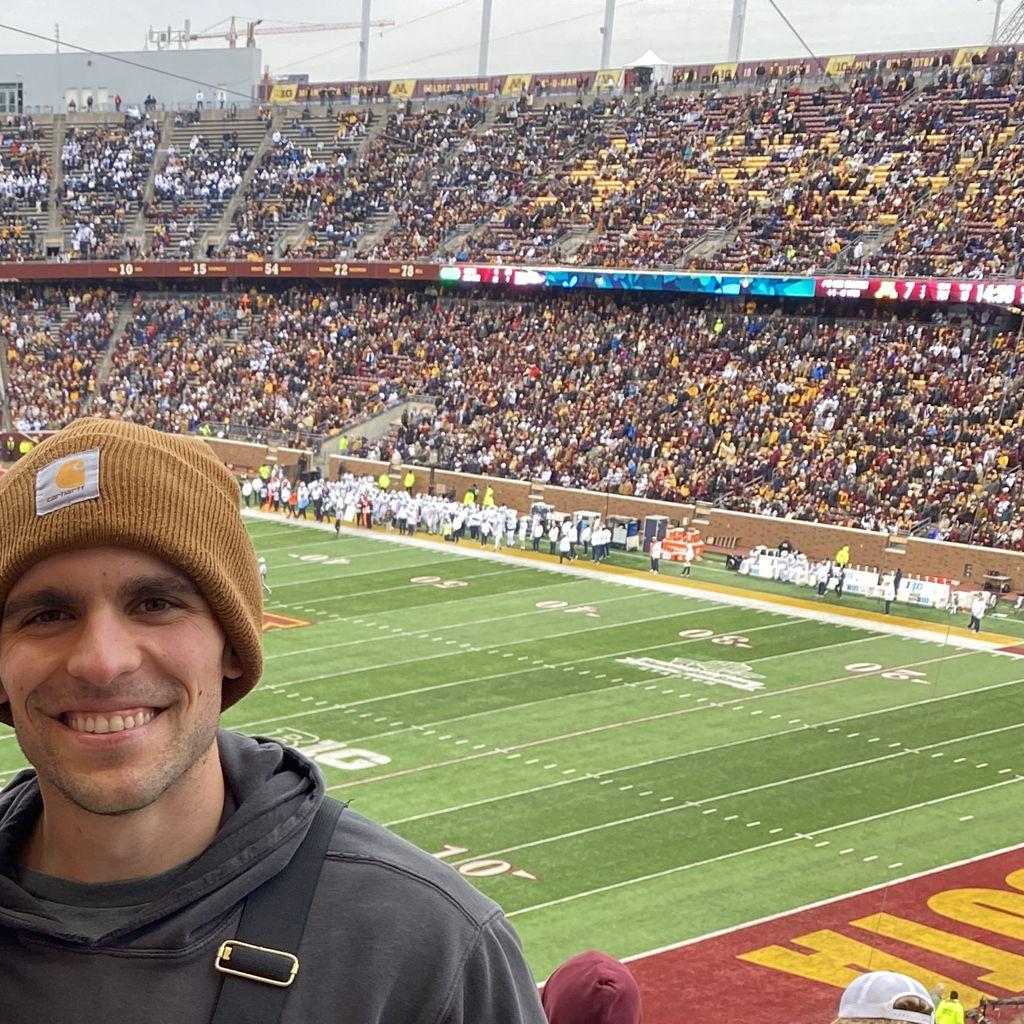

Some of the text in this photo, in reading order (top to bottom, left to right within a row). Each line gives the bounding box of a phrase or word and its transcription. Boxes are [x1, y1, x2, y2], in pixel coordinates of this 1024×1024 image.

[119, 263, 134, 275] 10
[193, 263, 207, 275] 15
[264, 263, 279, 276] 54
[335, 264, 348, 276] 72
[401, 265, 414, 277] 78
